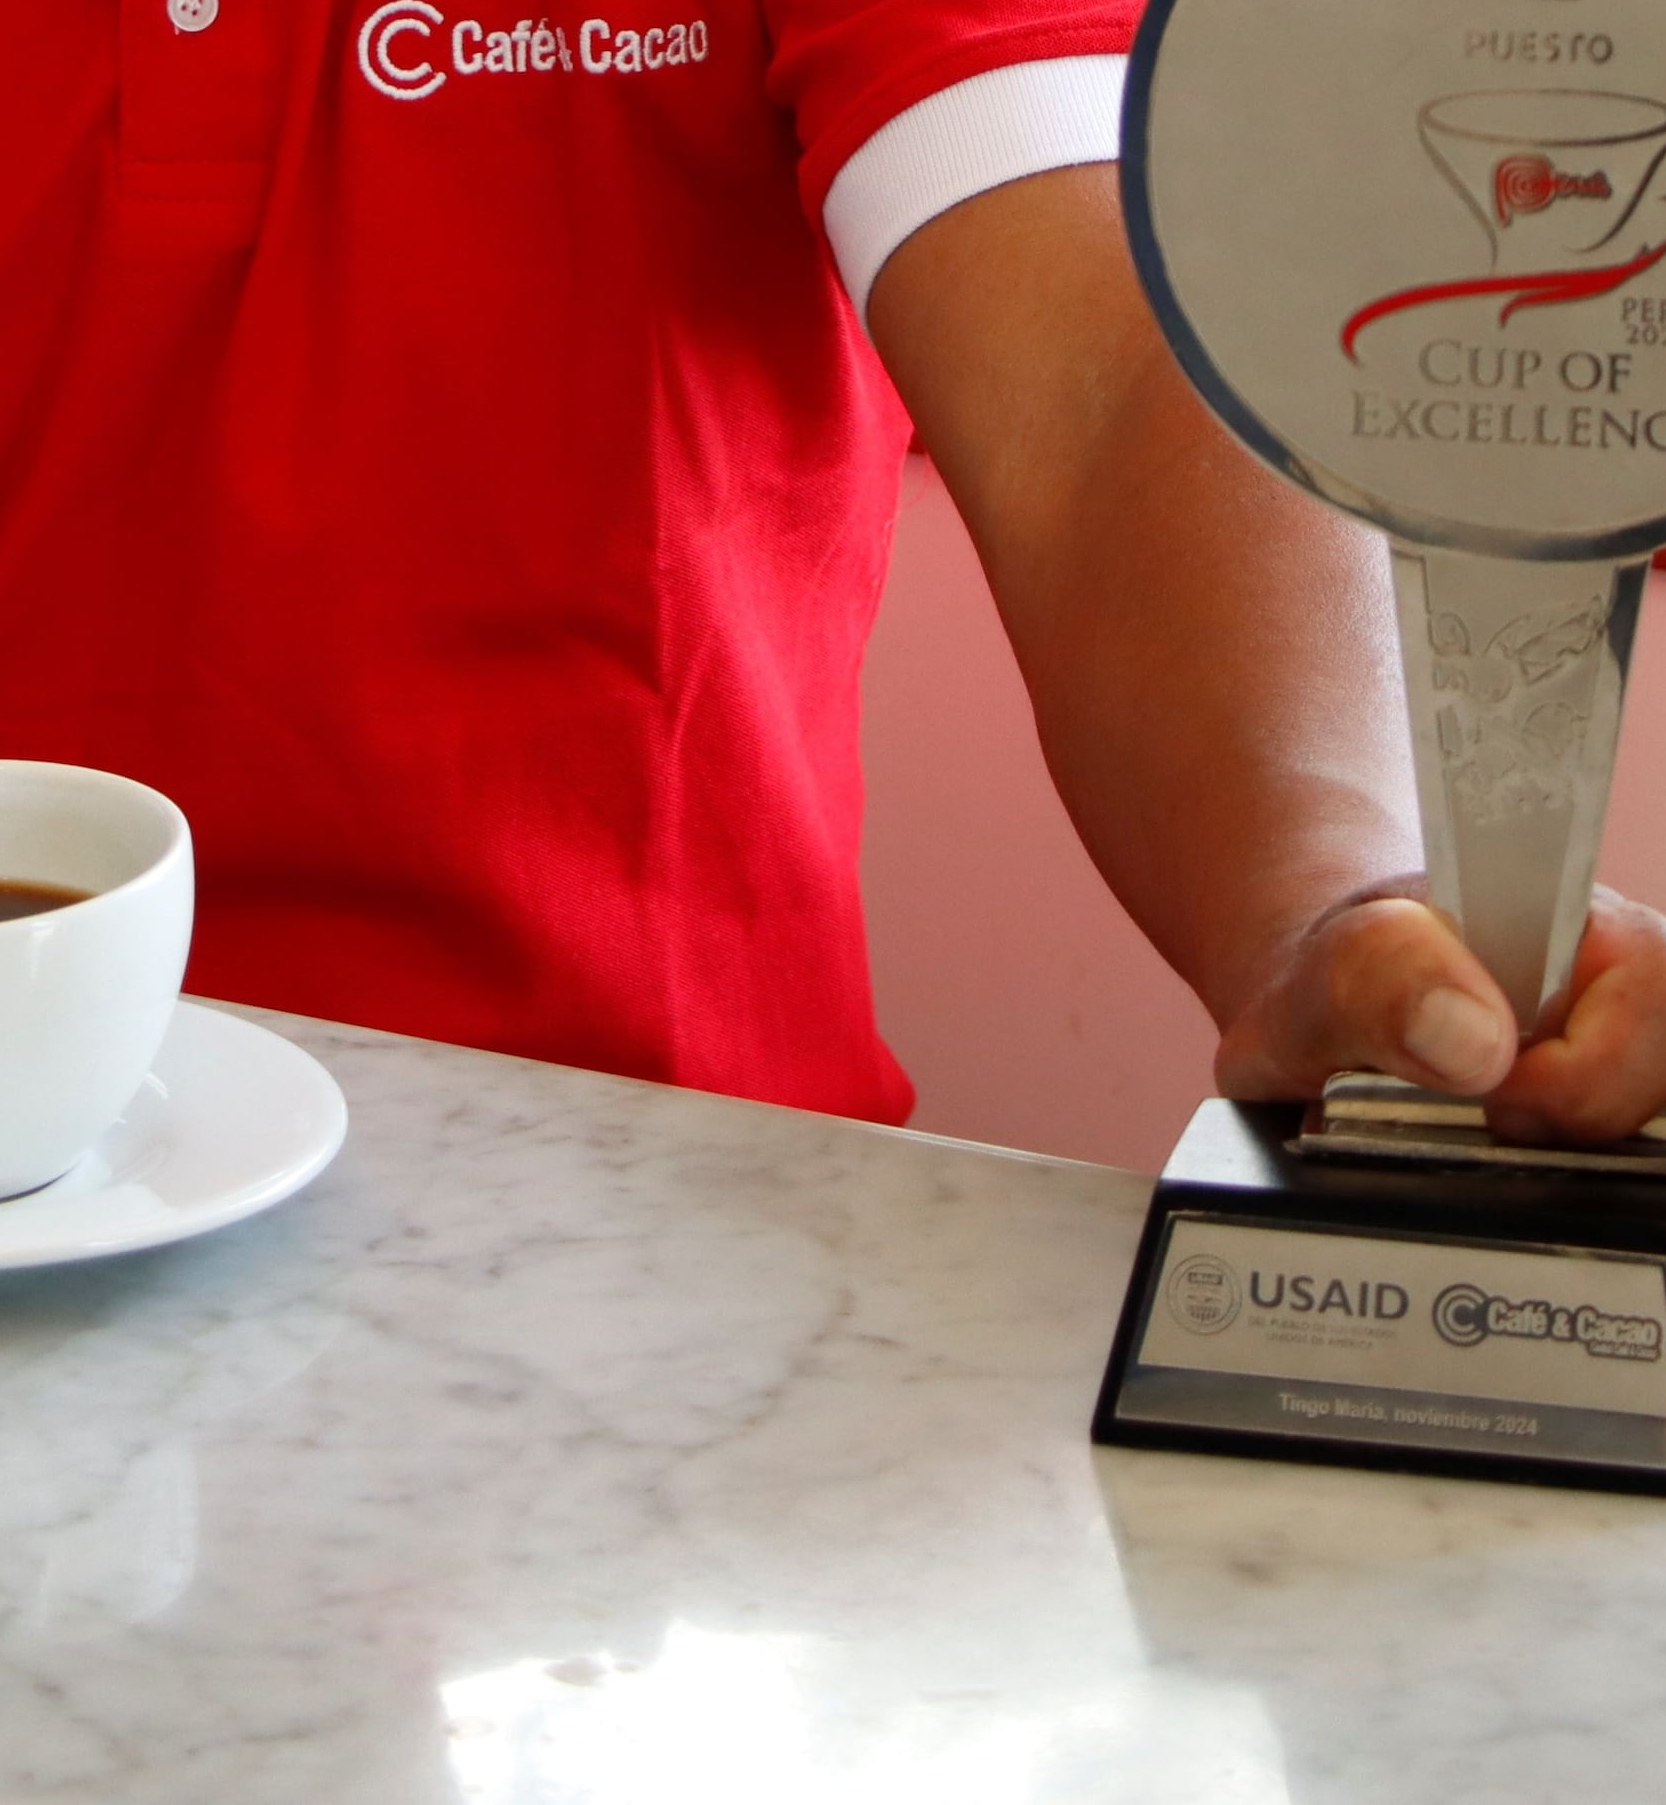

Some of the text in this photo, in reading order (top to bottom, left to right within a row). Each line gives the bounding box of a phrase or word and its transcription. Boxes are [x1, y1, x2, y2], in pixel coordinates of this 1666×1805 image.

[451, 16, 556, 75] Café
[580, 18, 709, 75] Cacao
[1464, 30, 1615, 66] PUESTO
[1418, 338, 1633, 395] CUP OF
[1248, 1269, 1410, 1321] USAID
[1486, 1297, 1550, 1336] Café
[1551, 1308, 1573, 1339] &
[1575, 1305, 1661, 1346] Cacao
[1279, 1392, 1331, 1419] Tingo
[1393, 1407, 1491, 1432] noviembre
[1494, 1413, 1539, 1437] 2024
